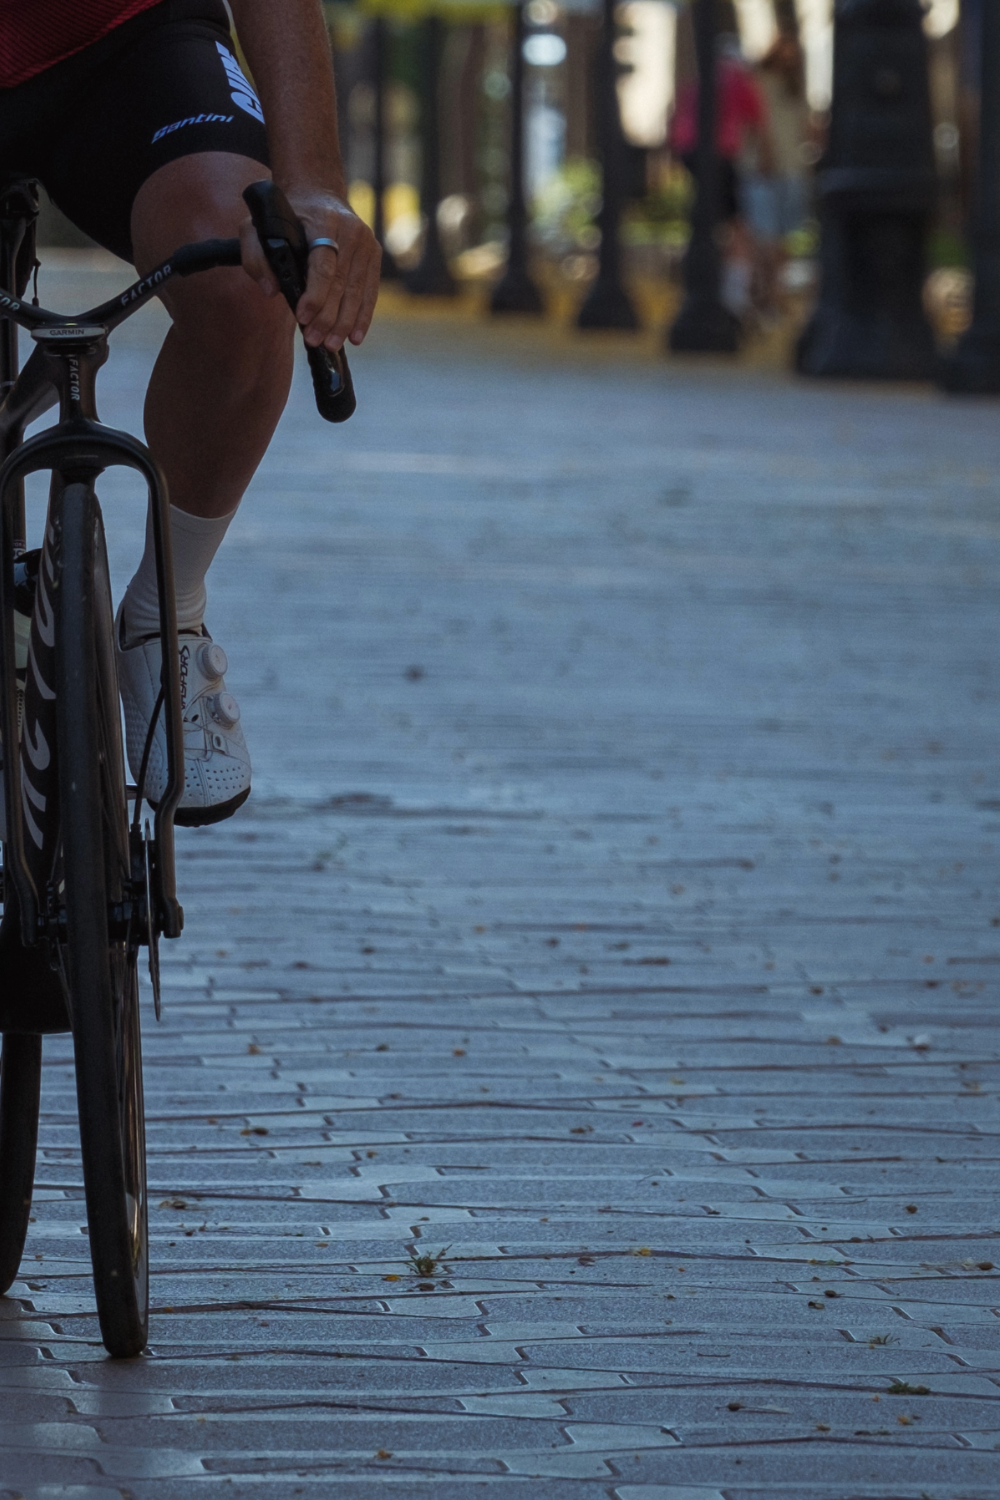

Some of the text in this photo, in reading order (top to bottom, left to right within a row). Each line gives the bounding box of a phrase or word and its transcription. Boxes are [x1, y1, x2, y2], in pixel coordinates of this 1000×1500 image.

[151, 112, 235, 145] Santini
[120, 263, 172, 307] FACTOR
[50, 328, 85, 336] GARMIN
[68, 357, 81, 401] FACTOR
